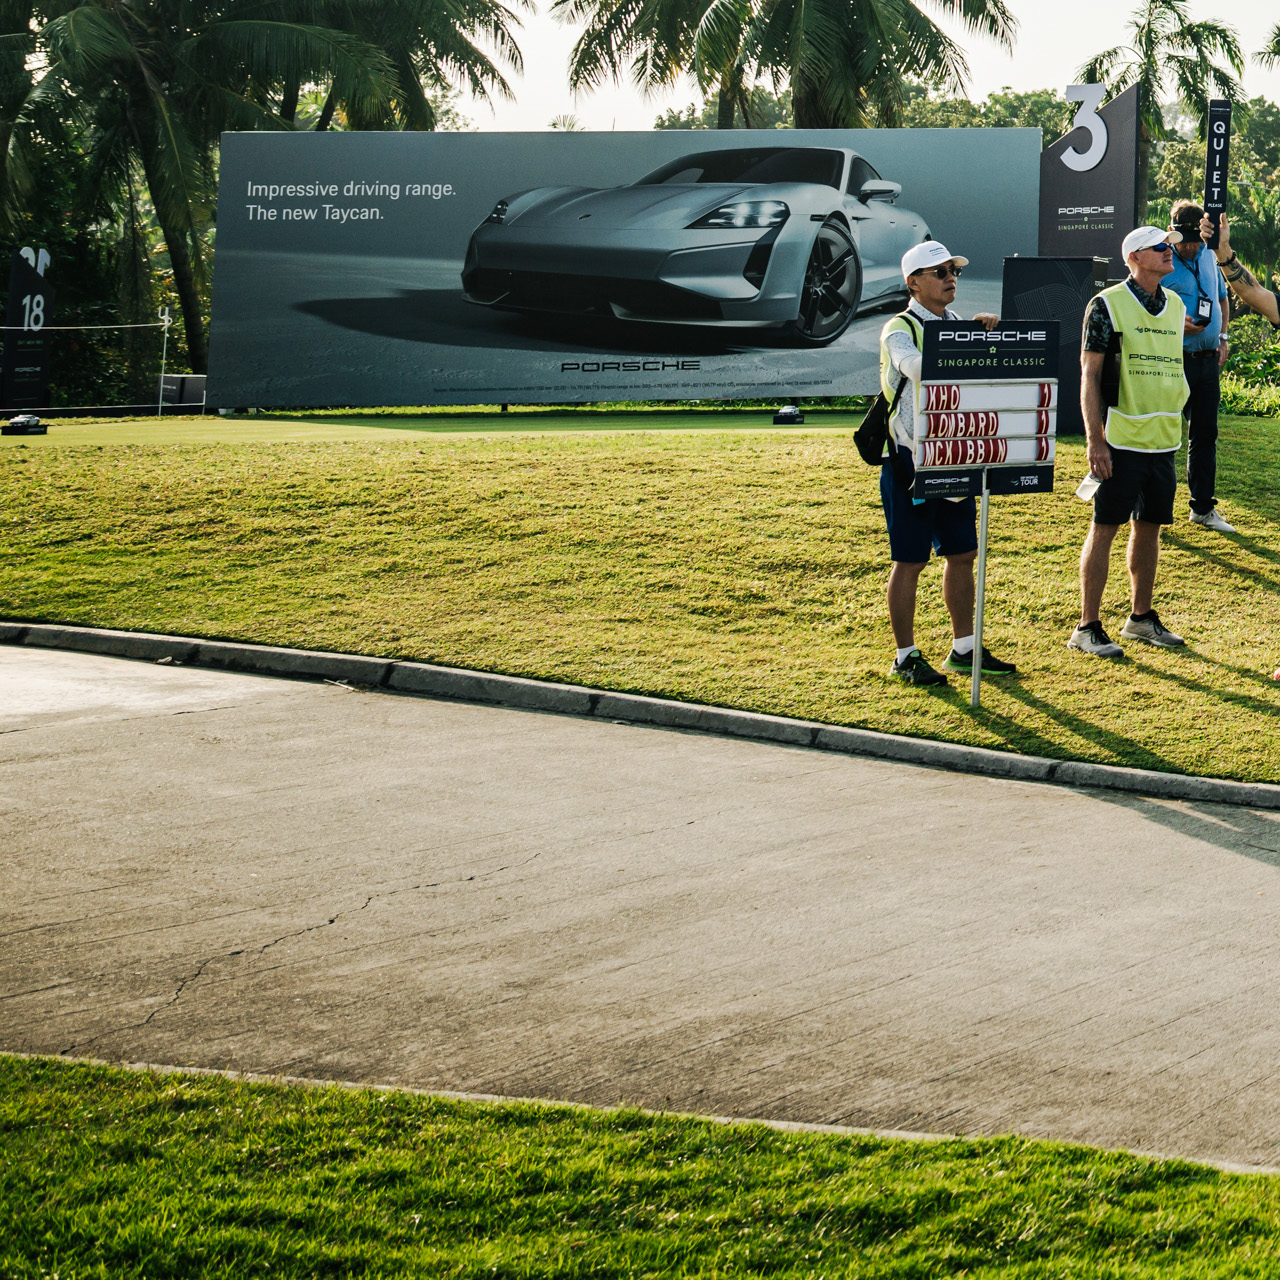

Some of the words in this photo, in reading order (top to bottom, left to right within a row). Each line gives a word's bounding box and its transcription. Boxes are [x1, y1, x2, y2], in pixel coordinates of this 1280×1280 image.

[1060, 83, 1108, 172] 3
[1211, 121, 1226, 200] QUIET
[247, 181, 338, 200] Impressive
[343, 180, 400, 200] driving
[405, 184, 456, 200] range.
[246, 204, 277, 221] The
[282, 208, 318, 220] new
[322, 204, 384, 224] Taycan.
[1058, 206, 1115, 215] PORSCHE
[22, 294, 45, 332] 18
[938, 331, 1046, 342] PORSCHE
[561, 360, 701, 373] PORSCHE
[938, 358, 998, 367] SINGAPORE
[1003, 357, 1046, 366] CLASSIC
[1128, 353, 1182, 364] PORSCHE
[928, 385, 960, 411] KHO
[1043, 383, 1049, 408] 1
[928, 412, 998, 438] LOMBARD
[1041, 410, 1047, 434] 1
[923, 439, 1007, 467] MCKIBBIN
[1041, 437, 1047, 461] 1
[924, 477, 970, 485] PORSCHE
